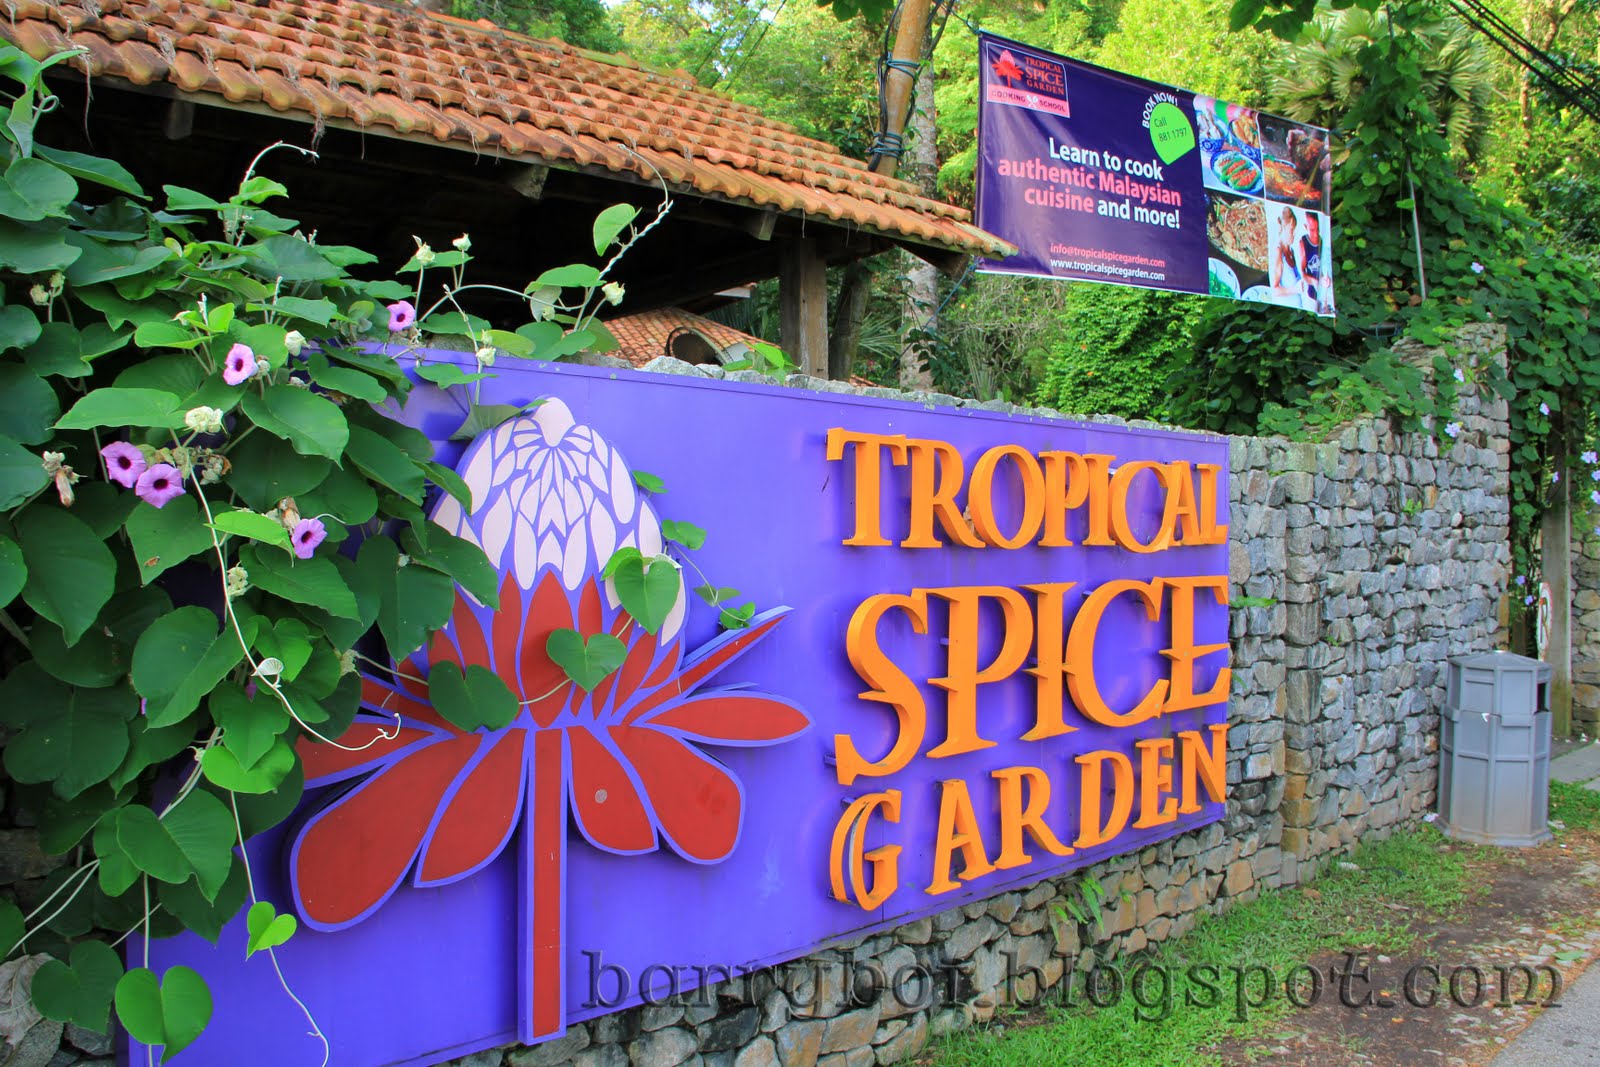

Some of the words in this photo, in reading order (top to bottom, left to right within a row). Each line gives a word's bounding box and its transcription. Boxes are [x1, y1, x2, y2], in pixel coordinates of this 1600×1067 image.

[1025, 56, 1062, 73] TROPICAL
[1025, 67, 1064, 87] SPICE
[1026, 80, 1064, 95] GARDEN
[991, 90, 1025, 103] COOKING
[1039, 100, 1066, 112] SCHOOL
[1142, 96, 1157, 129] BOOK
[1153, 92, 1178, 106] NOW!
[1154, 117, 1167, 127] Call
[1158, 131, 1170, 142] 881
[1171, 127, 1187, 139] 1797
[1049, 137, 1100, 167] Learn
[1103, 151, 1121, 172] to
[1124, 158, 1164, 181] cook
[997, 158, 1095, 190] authentic
[1099, 171, 1182, 207] Malaysian
[1024, 186, 1095, 213] cuisine
[1097, 198, 1130, 220] and
[1134, 206, 1180, 230] more!
[1050, 242, 1166, 268] info@tropicalspicegarden.com
[1050, 258, 1165, 281] www.tropicalspicegarden.com
[826, 427, 1229, 554] TROPICAL
[834, 575, 1233, 786] SPICE
[829, 723, 1230, 912] GARDEN
